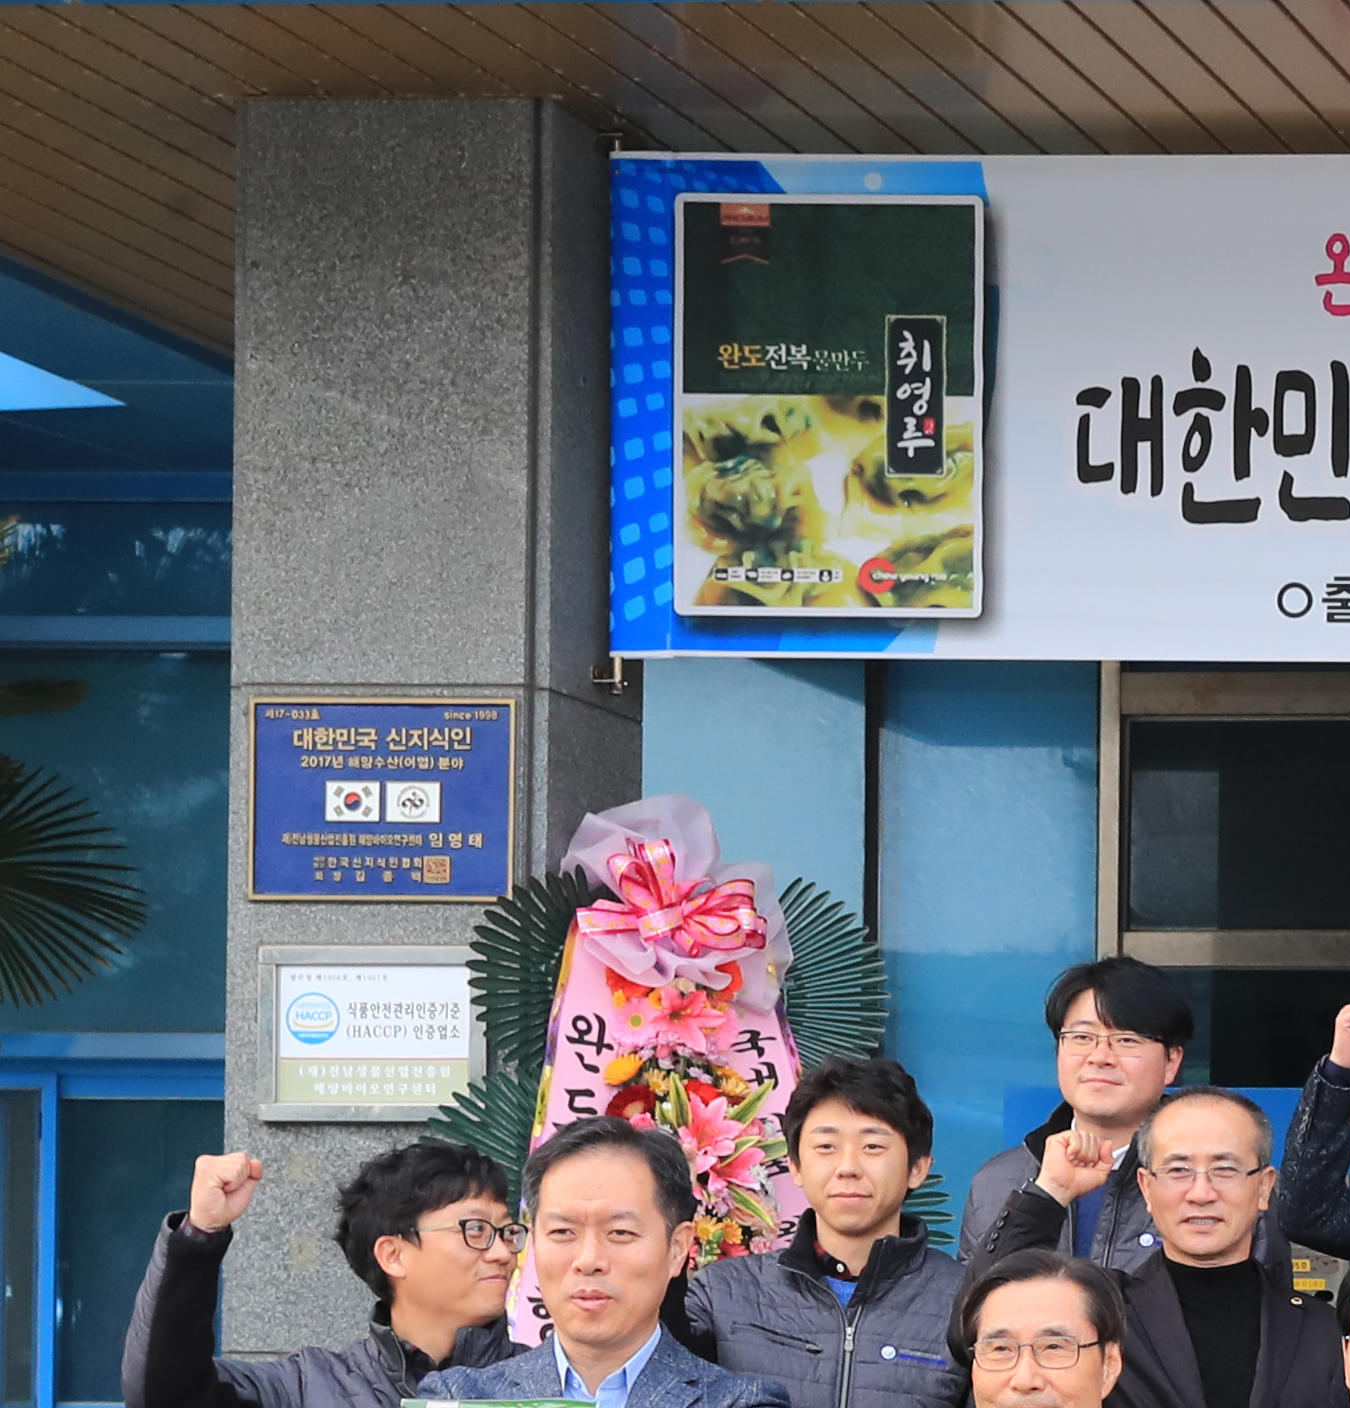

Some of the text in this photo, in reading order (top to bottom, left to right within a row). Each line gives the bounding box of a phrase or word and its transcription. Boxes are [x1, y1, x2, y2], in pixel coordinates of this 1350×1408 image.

[897, 331, 935, 457] 취영루
[443, 710, 498, 720] since 1998
[293, 727, 472, 751] 대한민국 신지식인
[301, 756, 344, 768] 2017년
[438, 757, 464, 770] 분야
[295, 1011, 332, 1021] HACCP
[347, 1002, 461, 1020] 식품안전관리인증기준
[346, 1024, 461, 1040] (HACCP) 인증업소
